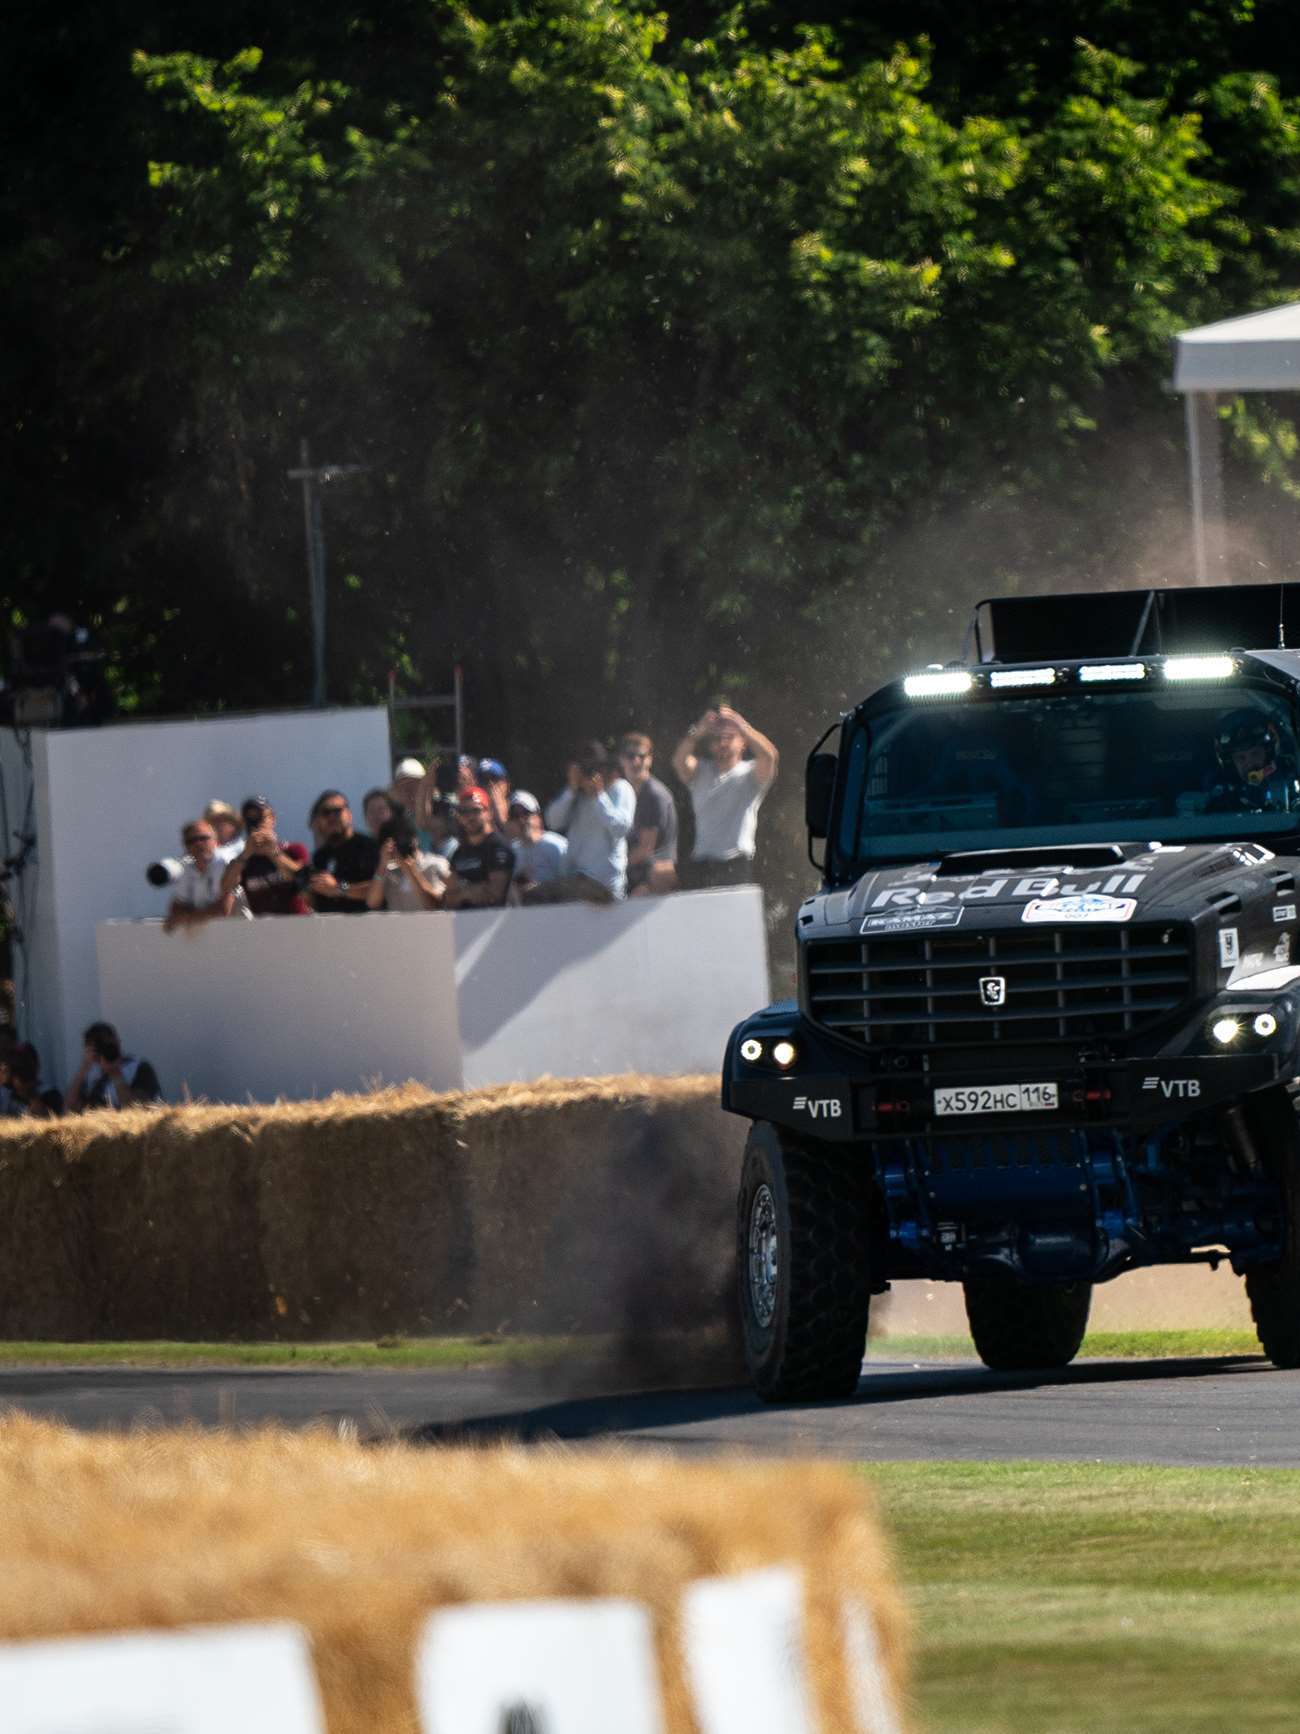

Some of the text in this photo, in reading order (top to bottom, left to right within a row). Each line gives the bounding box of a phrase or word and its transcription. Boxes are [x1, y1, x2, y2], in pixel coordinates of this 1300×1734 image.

[871, 873, 1147, 908] Red Bull
[1022, 1086, 1051, 1102] 116
[1161, 1079, 1201, 1098] VTB
[808, 1099, 842, 1118] VTB
